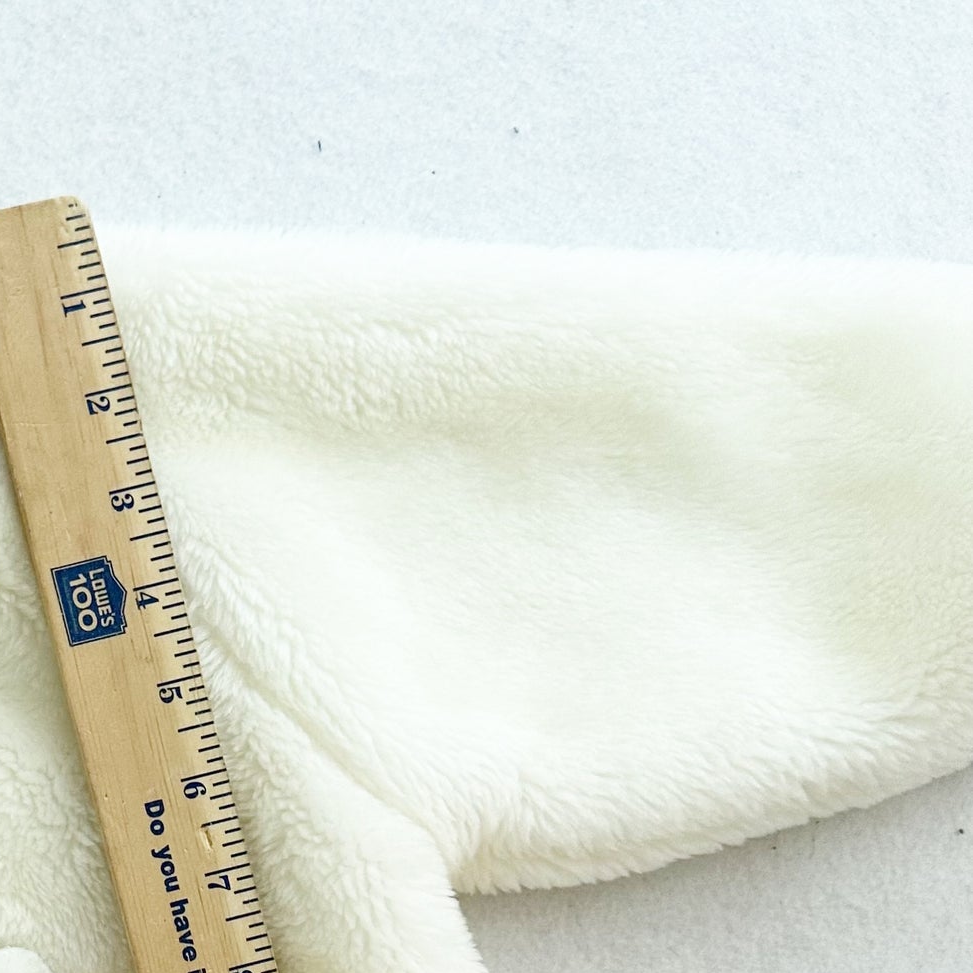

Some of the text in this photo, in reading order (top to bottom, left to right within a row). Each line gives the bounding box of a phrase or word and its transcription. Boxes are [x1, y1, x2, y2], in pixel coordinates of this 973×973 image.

[62, 300, 86, 317] 1
[86, 396, 110, 415] 2
[111, 493, 135, 512] 3
[69, 573, 98, 632] 100
[89, 567, 115, 628] LOWE'S
[135, 591, 160, 610] 4
[159, 686, 183, 704] 5
[183, 781, 207, 799] 6
[144, 799, 165, 836] Do
[151, 845, 180, 893] you
[207, 875, 231, 891] 7
[170, 898, 197, 962] have
